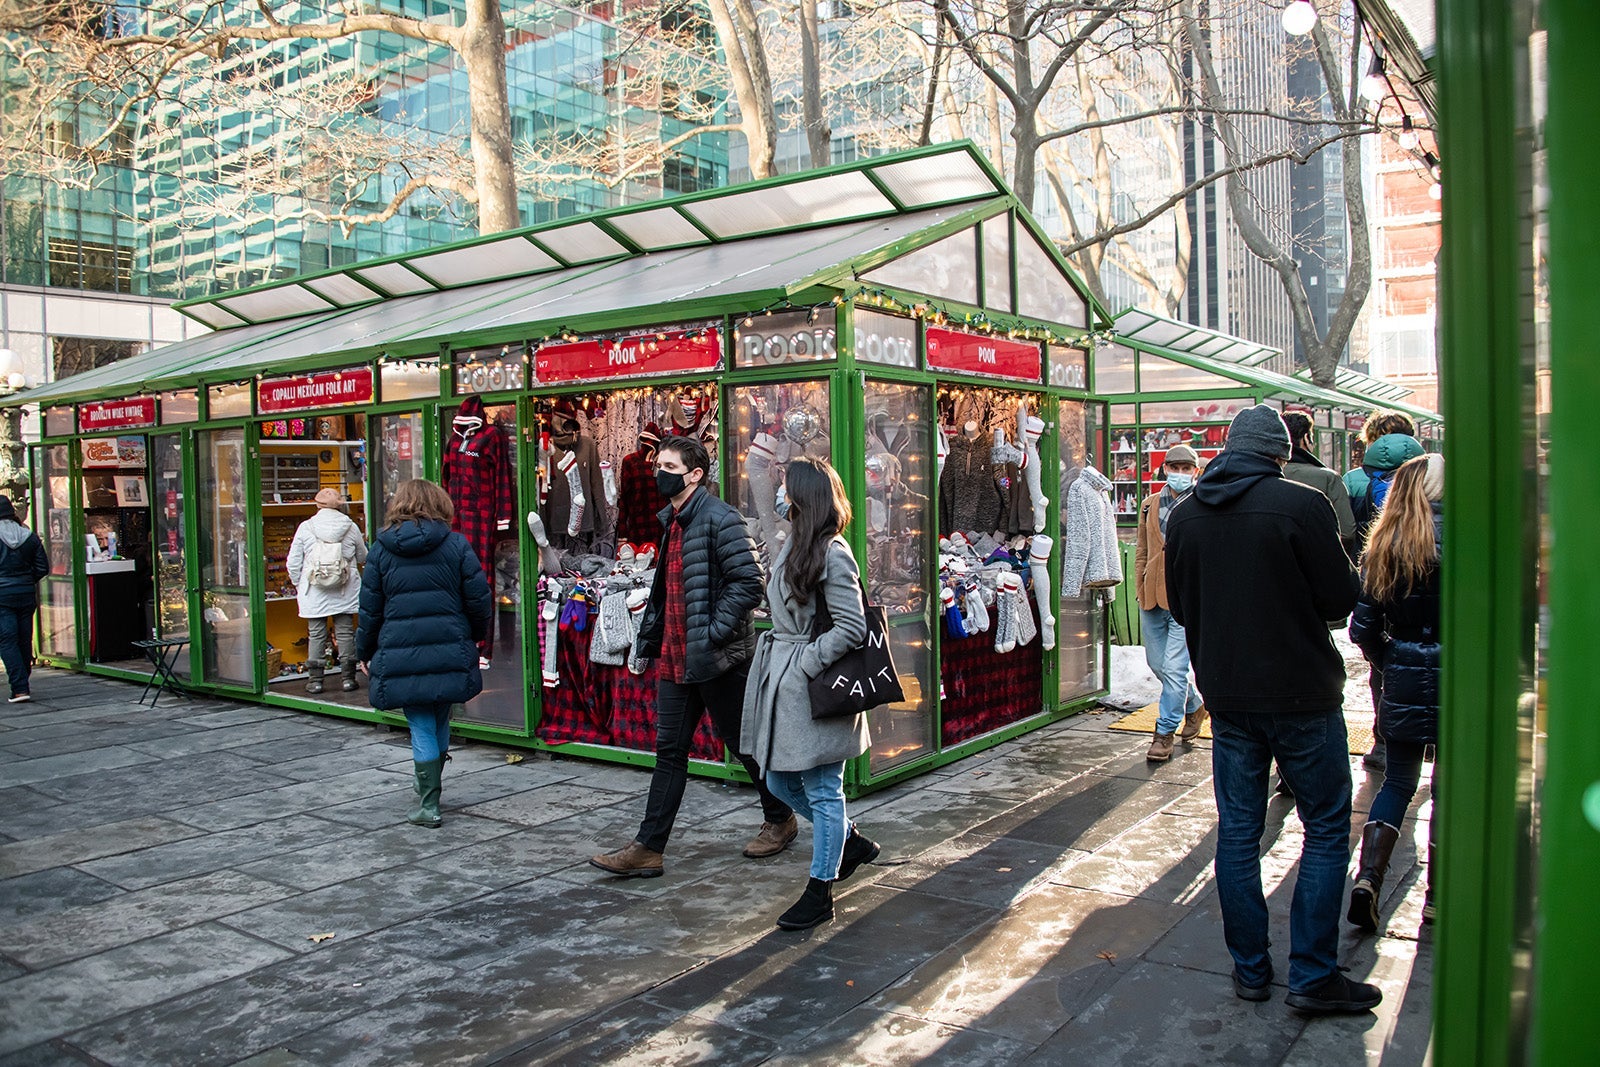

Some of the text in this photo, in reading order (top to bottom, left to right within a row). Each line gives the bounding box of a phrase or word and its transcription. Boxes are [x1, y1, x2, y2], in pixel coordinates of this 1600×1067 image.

[608, 347, 637, 365] POOK
[743, 327, 837, 367] POOK
[978, 346, 996, 364] POOK
[272, 386, 296, 401] COPALLI
[297, 383, 324, 398] MEXICAN
[326, 381, 341, 395] FOLK
[343, 379, 356, 393] ART
[458, 363, 521, 394] POOK
[831, 666, 892, 697] FAIT
